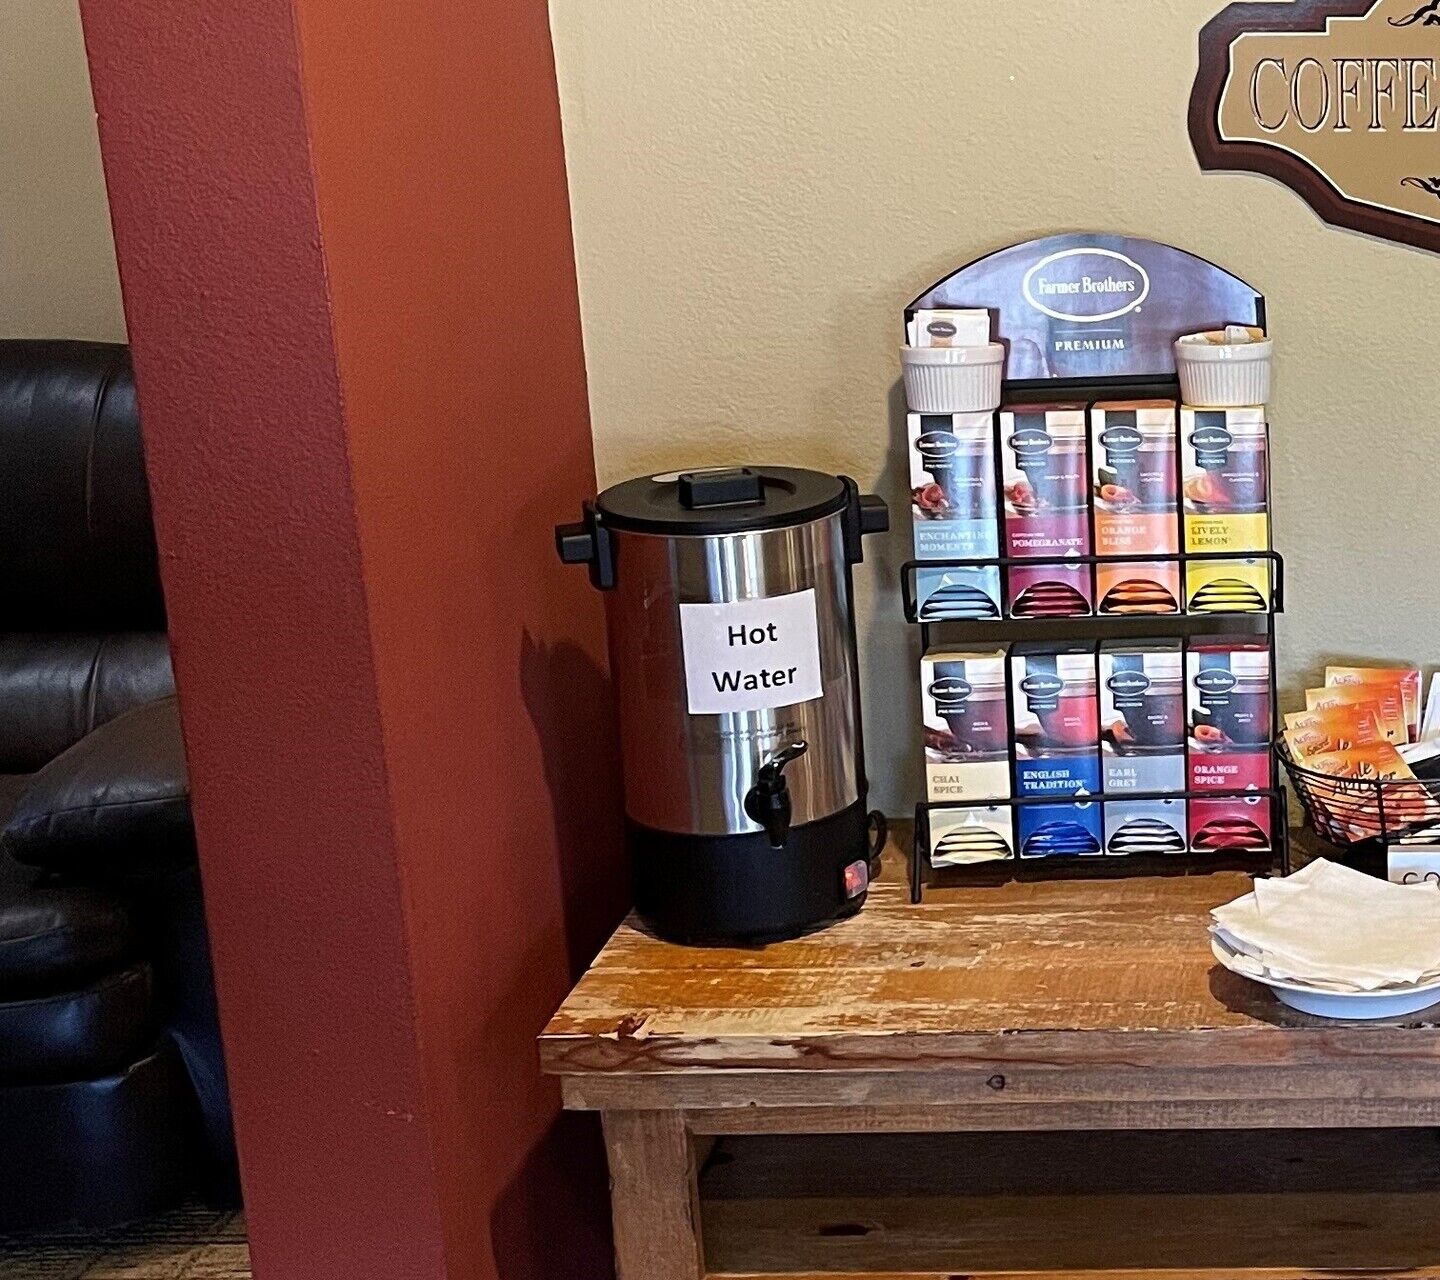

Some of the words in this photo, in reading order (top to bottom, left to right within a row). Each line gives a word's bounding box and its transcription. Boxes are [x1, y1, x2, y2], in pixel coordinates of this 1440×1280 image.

[1038, 277, 1081, 295] Farmer
[1081, 275, 1135, 294] Brothers
[1054, 338, 1125, 352] PREMIUM
[1191, 526, 1230, 535] LIVELY
[1011, 537, 1084, 548] POMEGRANATE
[1191, 536, 1229, 546] LEMON
[728, 622, 778, 647] Hot
[711, 666, 797, 693] Water
[1023, 769, 1070, 780] ENGLISH
[1108, 767, 1138, 777] EARL
[1193, 765, 1239, 774] ORANGE
[932, 775, 960, 784] CHAI
[1023, 779, 1083, 790] TRADITION
[1108, 778, 1138, 787] GREY
[1194, 775, 1225, 785] SPICE
[933, 785, 964, 795] SPICE
